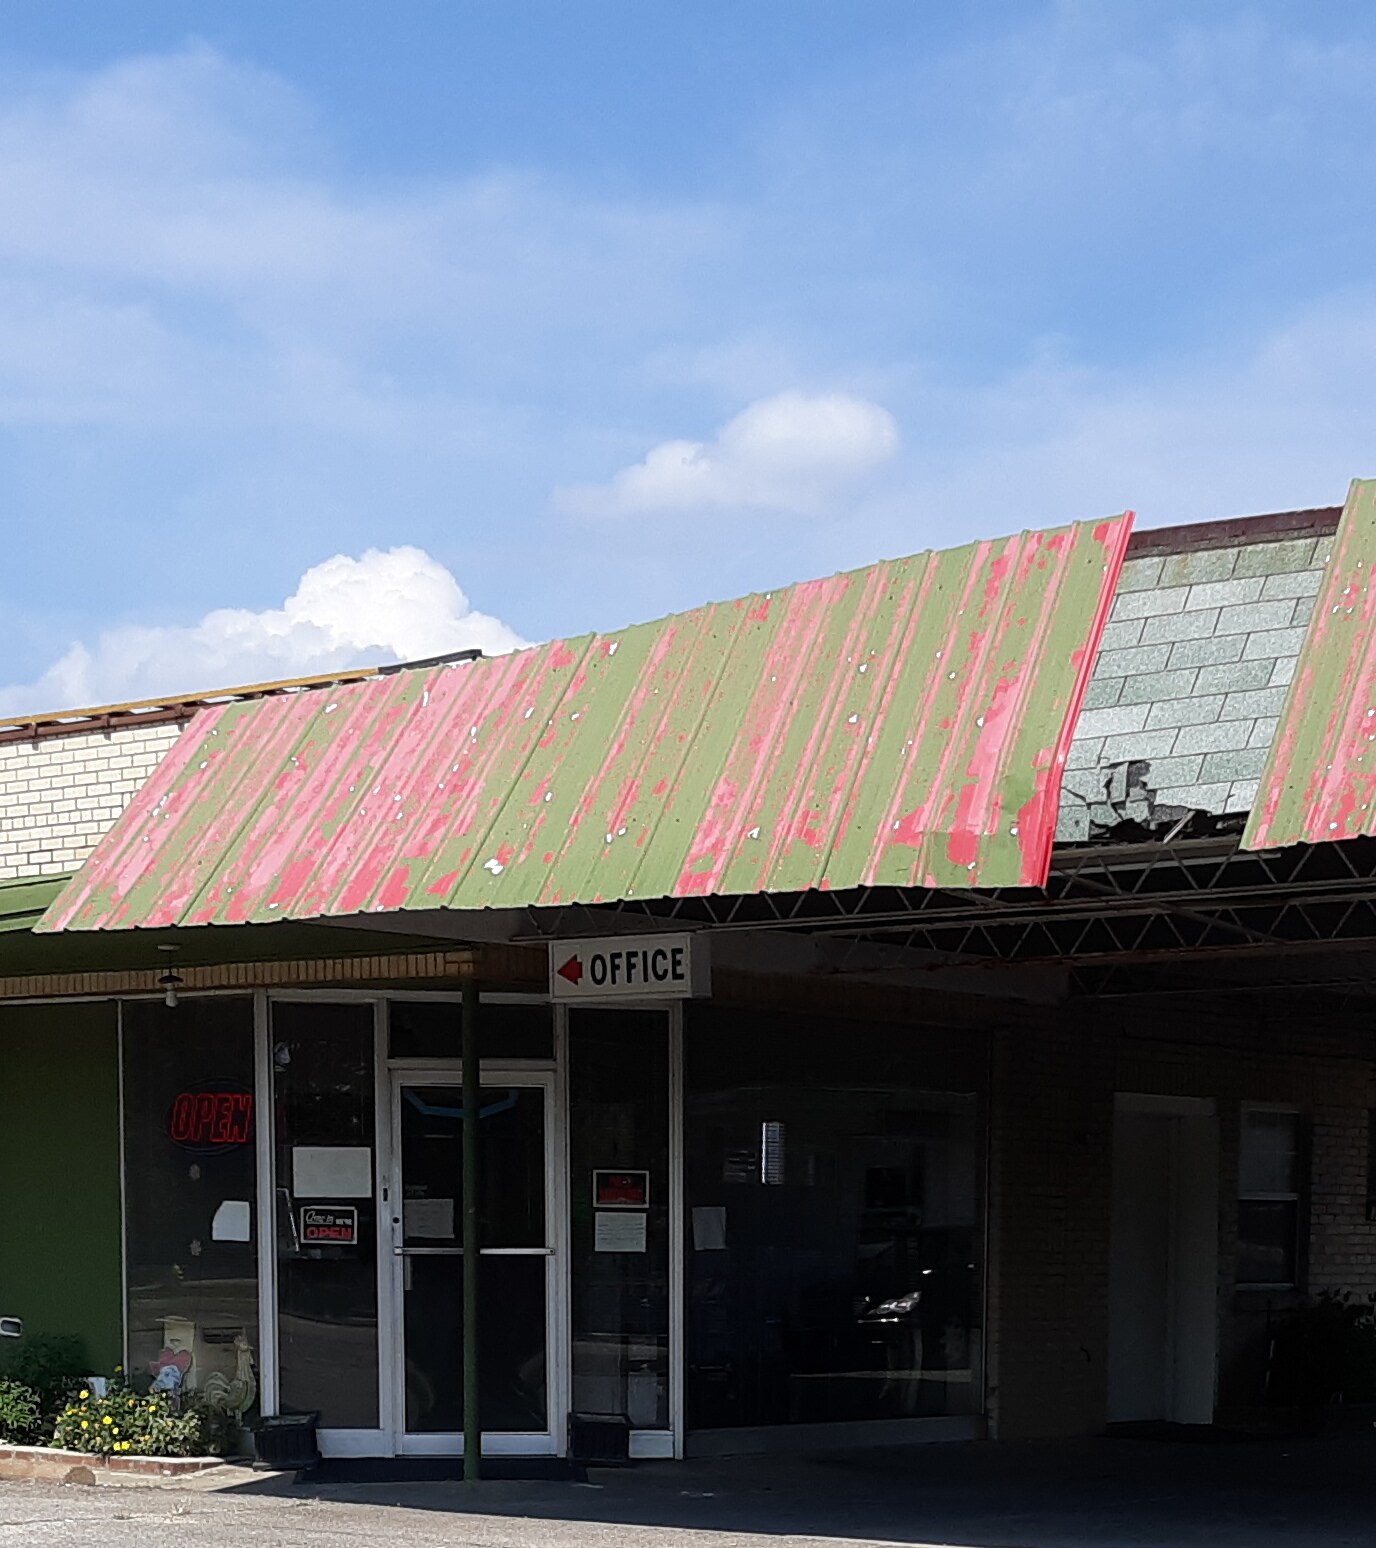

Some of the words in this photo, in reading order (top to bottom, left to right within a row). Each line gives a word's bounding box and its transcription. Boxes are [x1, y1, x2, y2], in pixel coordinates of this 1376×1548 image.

[590, 948, 685, 985] OFFICE
[171, 1093, 252, 1142] OPEN
[306, 1227, 353, 1239] OPEN
